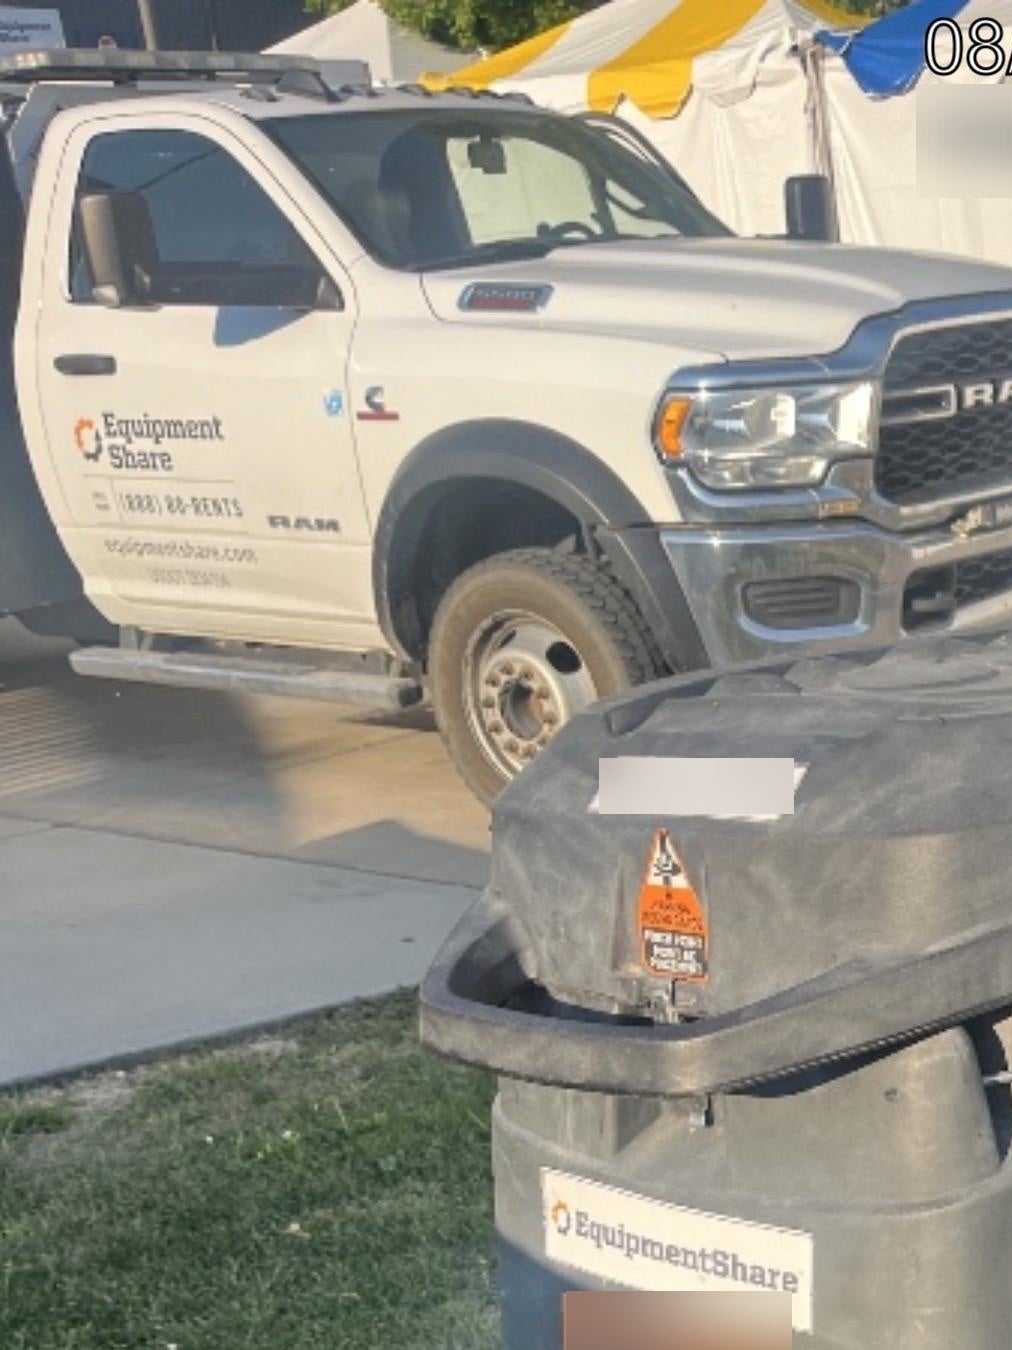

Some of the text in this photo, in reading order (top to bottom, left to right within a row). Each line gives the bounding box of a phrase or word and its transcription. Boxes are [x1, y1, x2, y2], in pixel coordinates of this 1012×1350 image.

[102, 411, 226, 445] Equipment
[107, 443, 174, 472] Share
[266, 514, 341, 533] RAM
[574, 1211, 799, 1293] EquipmentShare
